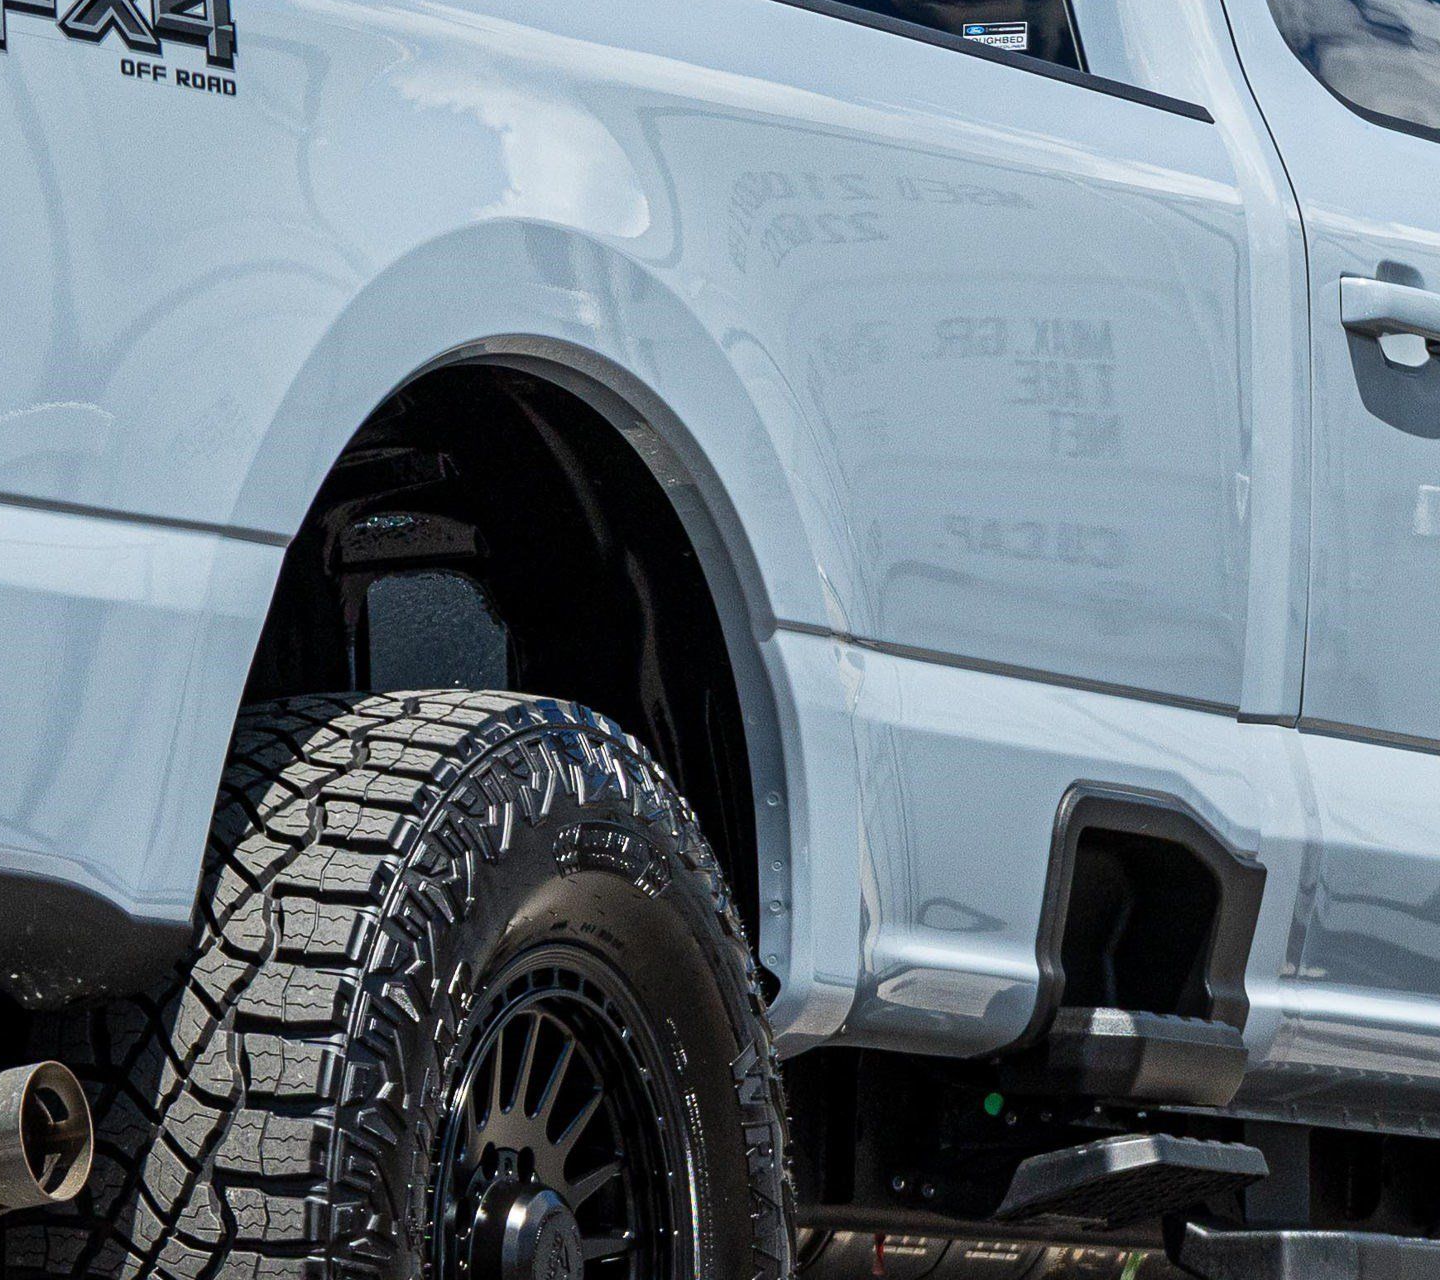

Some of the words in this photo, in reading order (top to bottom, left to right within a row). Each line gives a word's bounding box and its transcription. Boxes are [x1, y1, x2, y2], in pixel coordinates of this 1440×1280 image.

[971, 35, 1024, 45] OUGHBED
[120, 58, 167, 81] OFF
[176, 68, 237, 97] ROAD
